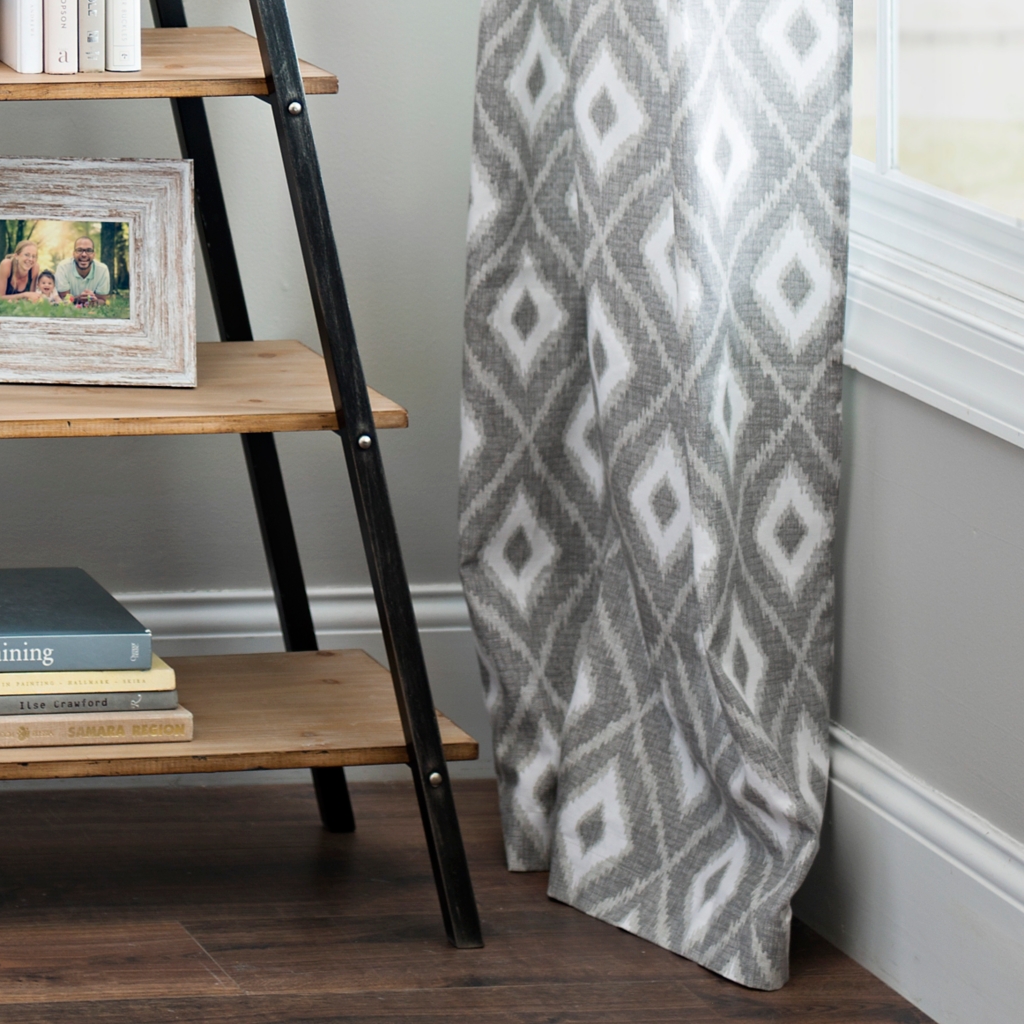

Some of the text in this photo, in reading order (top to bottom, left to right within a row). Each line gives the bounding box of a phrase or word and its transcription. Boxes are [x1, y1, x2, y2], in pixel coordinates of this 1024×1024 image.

[19, 697, 108, 710] Ilse Crawford
[67, 724, 126, 739] SAMARA
[132, 723, 185, 737] REGION
